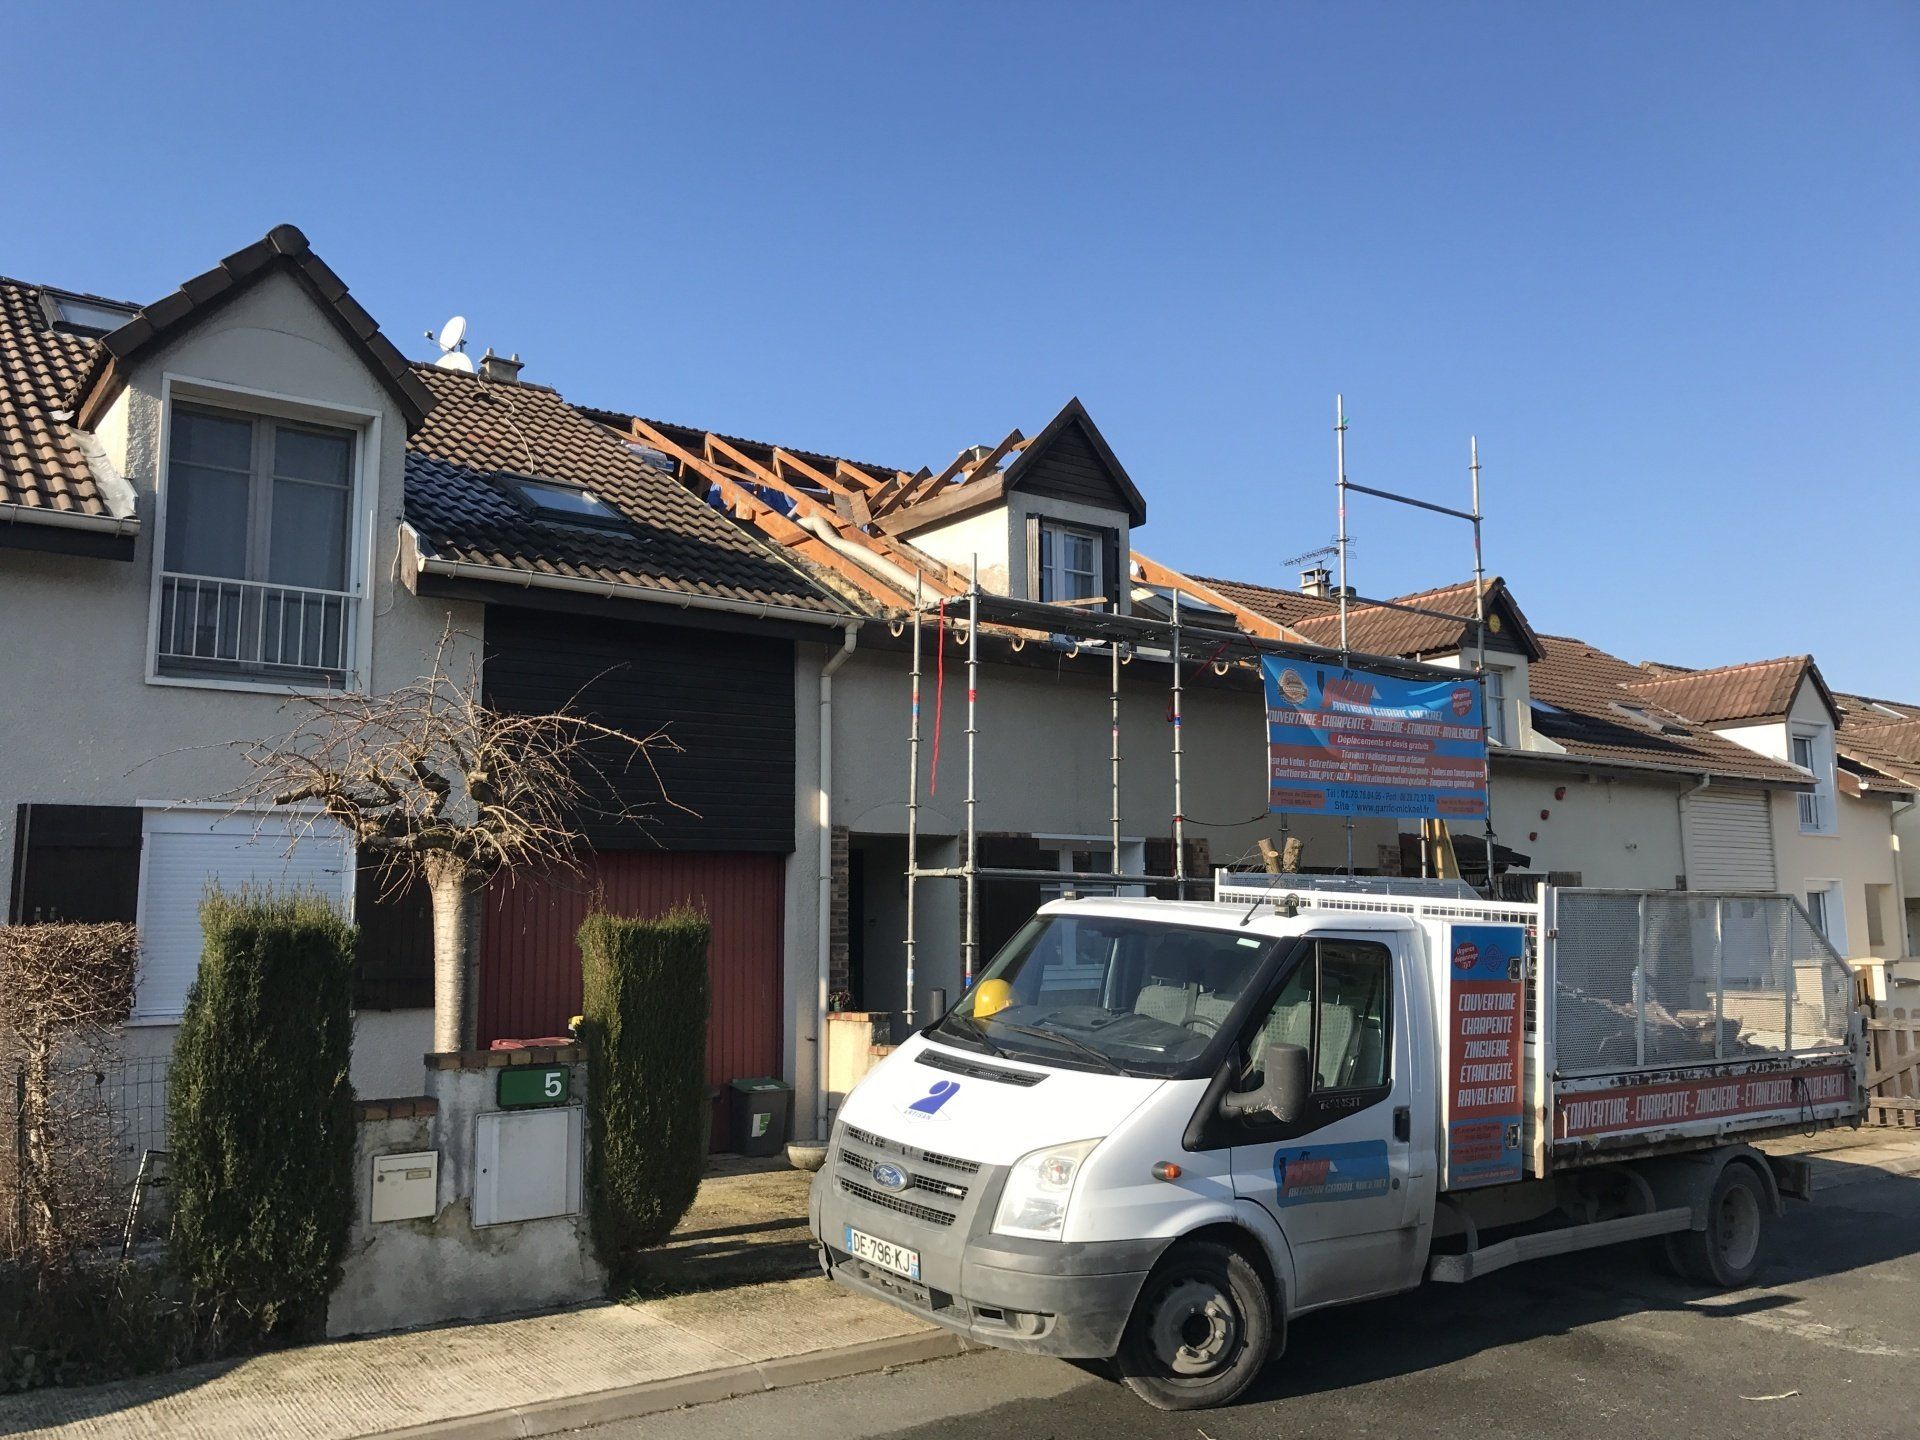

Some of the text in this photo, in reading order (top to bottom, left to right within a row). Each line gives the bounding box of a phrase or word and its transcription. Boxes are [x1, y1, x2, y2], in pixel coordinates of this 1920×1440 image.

[1332, 701, 1373, 716] ARTISAN
[1267, 710, 1317, 726] OUVERTURE
[1322, 714, 1366, 730] CHARPENTE
[1370, 719, 1404, 734] ZINGUERIE
[1392, 739, 1408, 748] devis
[1341, 749, 1364, 760] Travaux
[1334, 801, 1349, 811] Site
[1459, 993, 1517, 1012] COUVERTURE
[1461, 1016, 1514, 1035] CHARPENTE
[1464, 1039, 1511, 1059] ZINGUERIE
[544, 1072, 562, 1097] 5
[1457, 1085, 1517, 1108] RAVALEMENT
[1636, 1090, 1690, 1121] CHARPENTE
[1695, 1084, 1740, 1114] ZINGUERIE
[903, 1109, 932, 1120] ARTISAN
